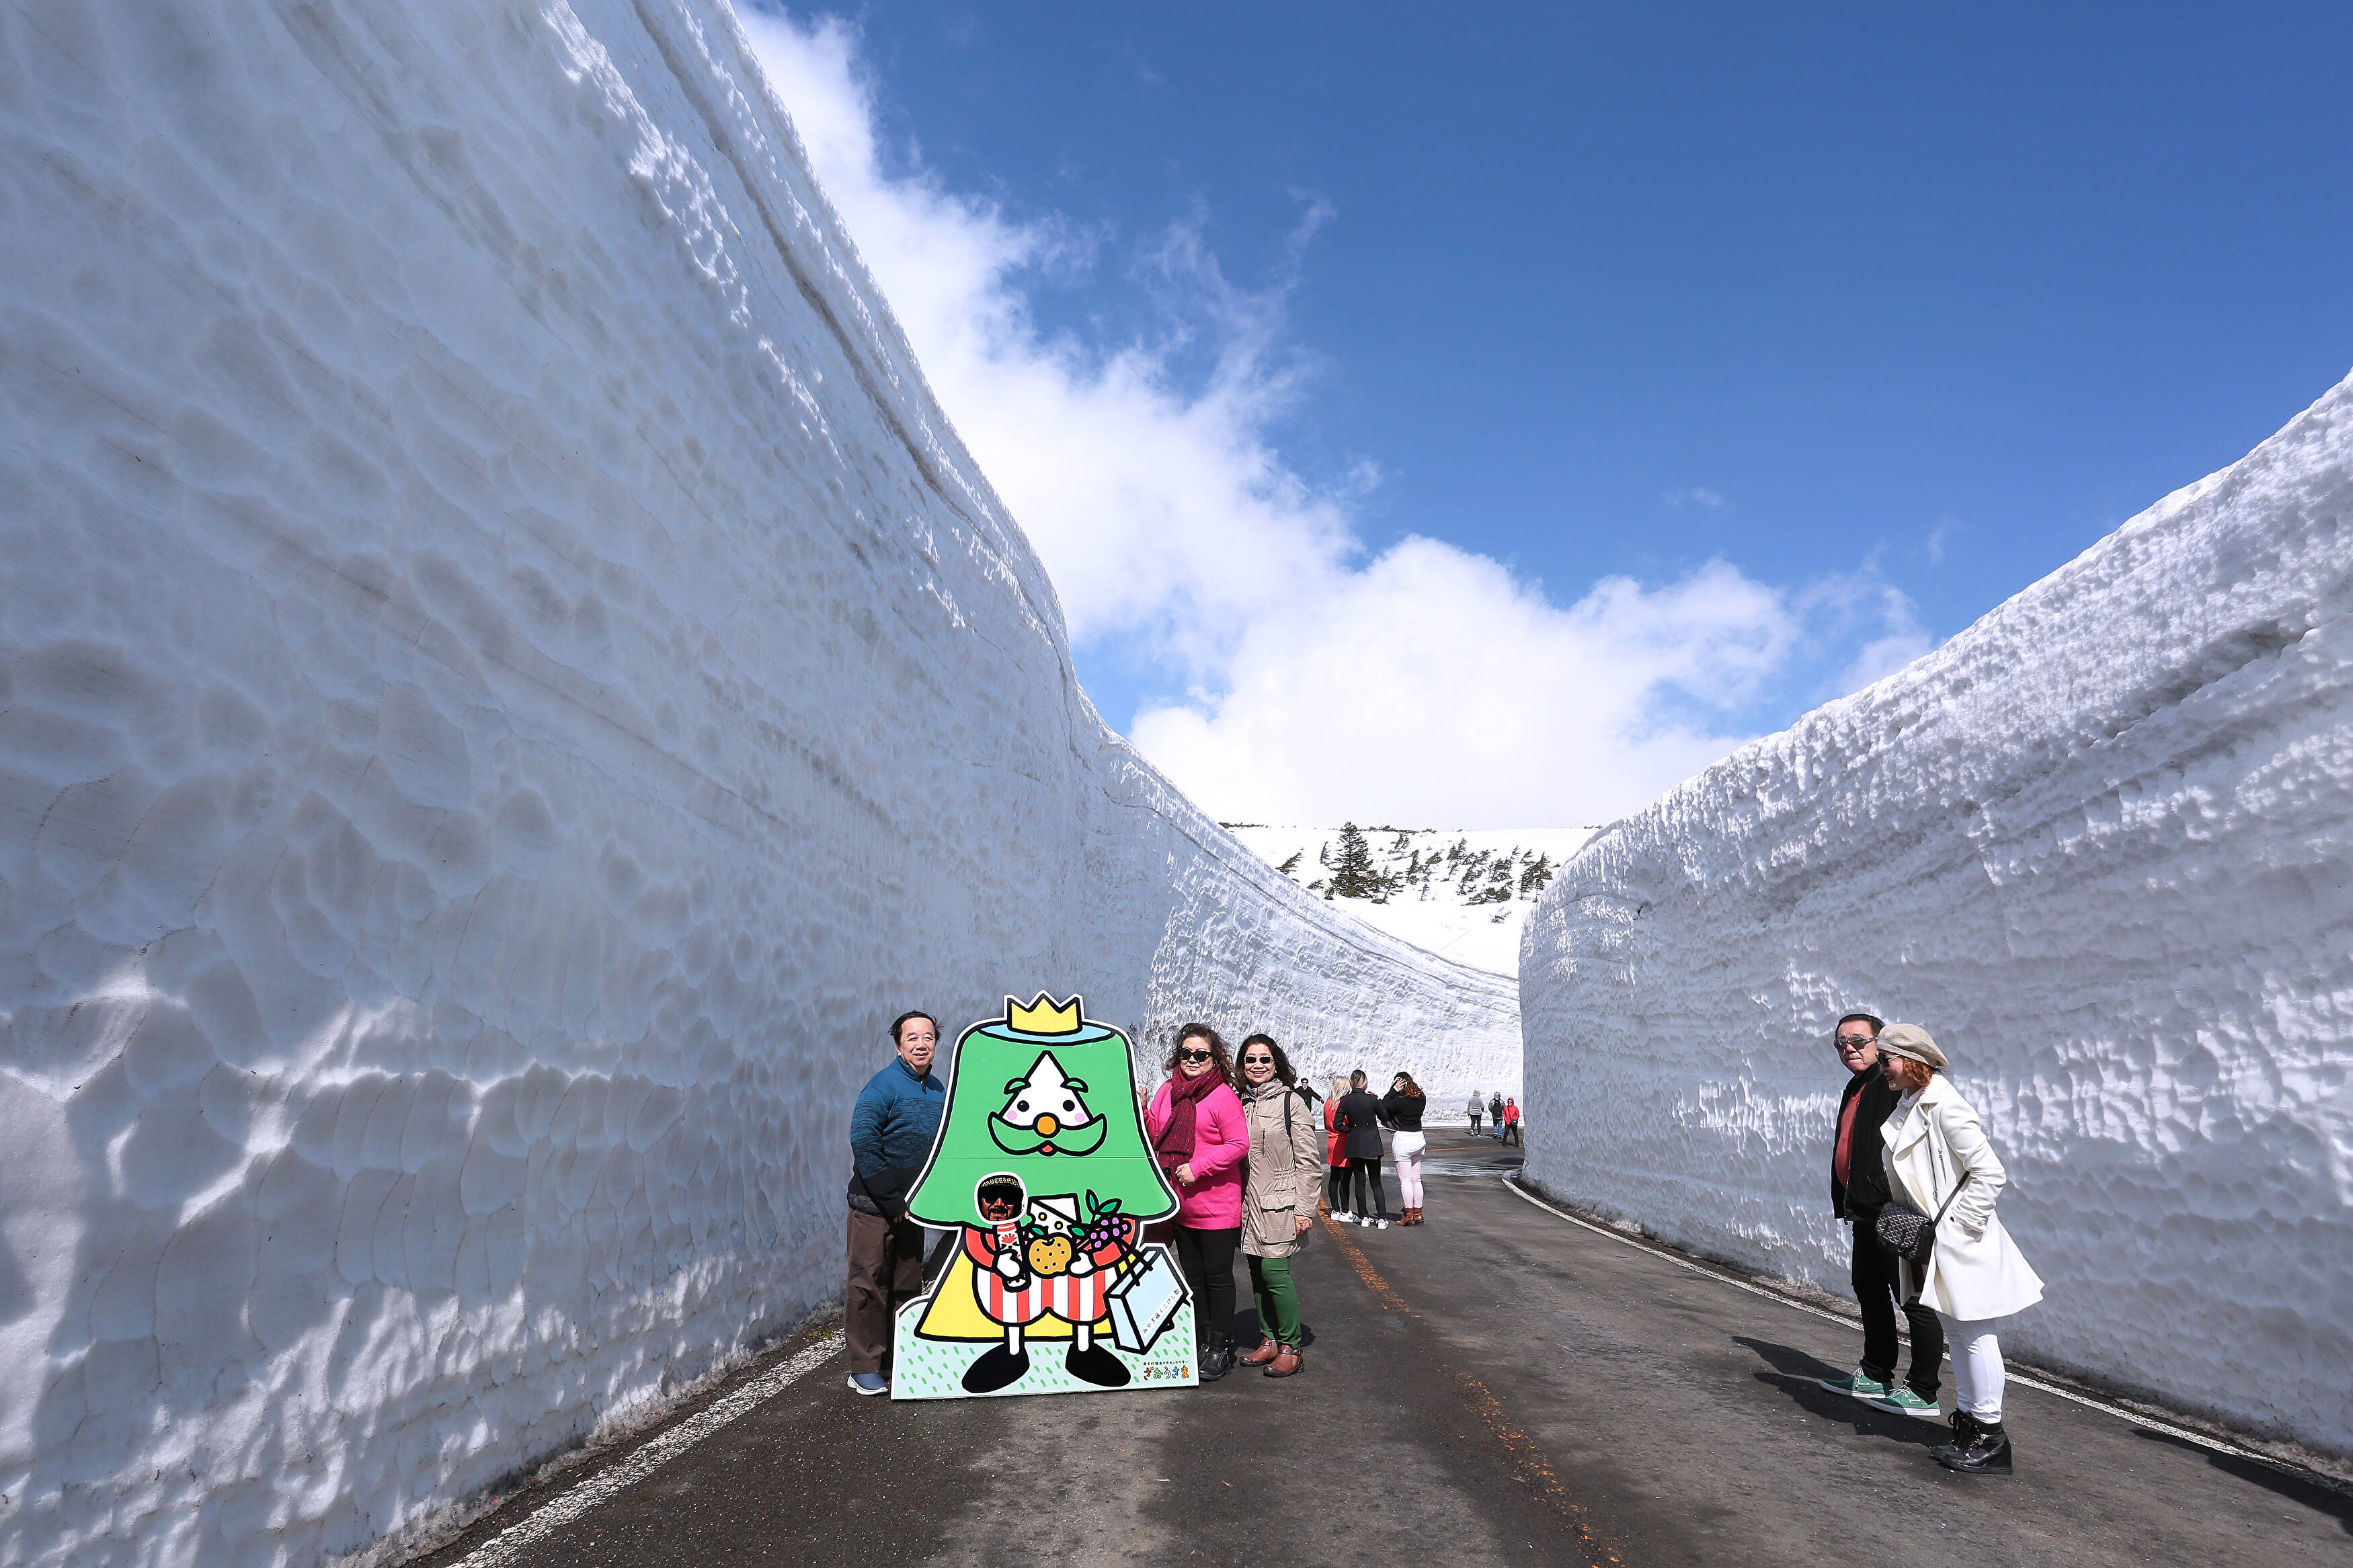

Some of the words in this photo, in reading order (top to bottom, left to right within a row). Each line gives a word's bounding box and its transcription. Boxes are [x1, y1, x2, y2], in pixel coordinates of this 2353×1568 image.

[1144, 1365, 1189, 1380] ざおうさま
